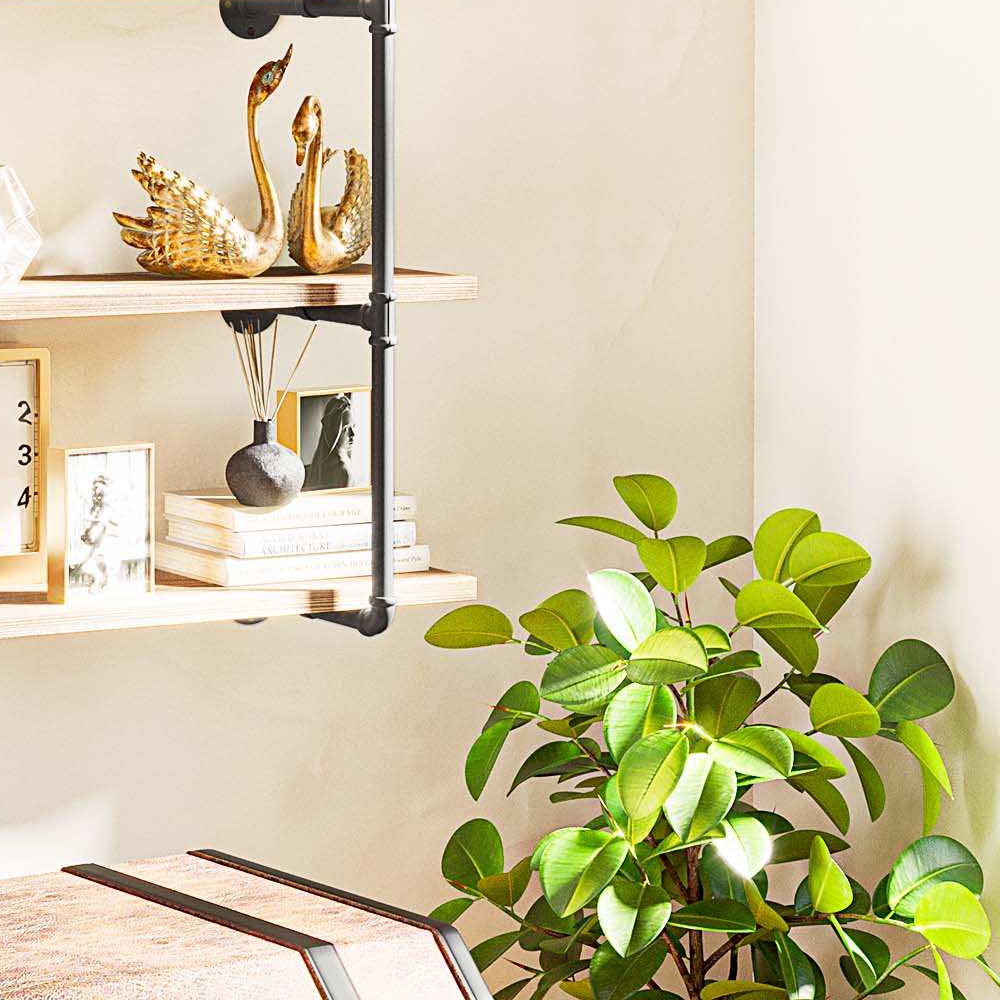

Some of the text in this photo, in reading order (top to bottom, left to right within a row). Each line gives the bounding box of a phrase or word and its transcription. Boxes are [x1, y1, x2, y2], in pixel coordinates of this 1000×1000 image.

[17, 399, 33, 425] 2
[17, 443, 33, 467] 3
[16, 485, 32, 510] 4
